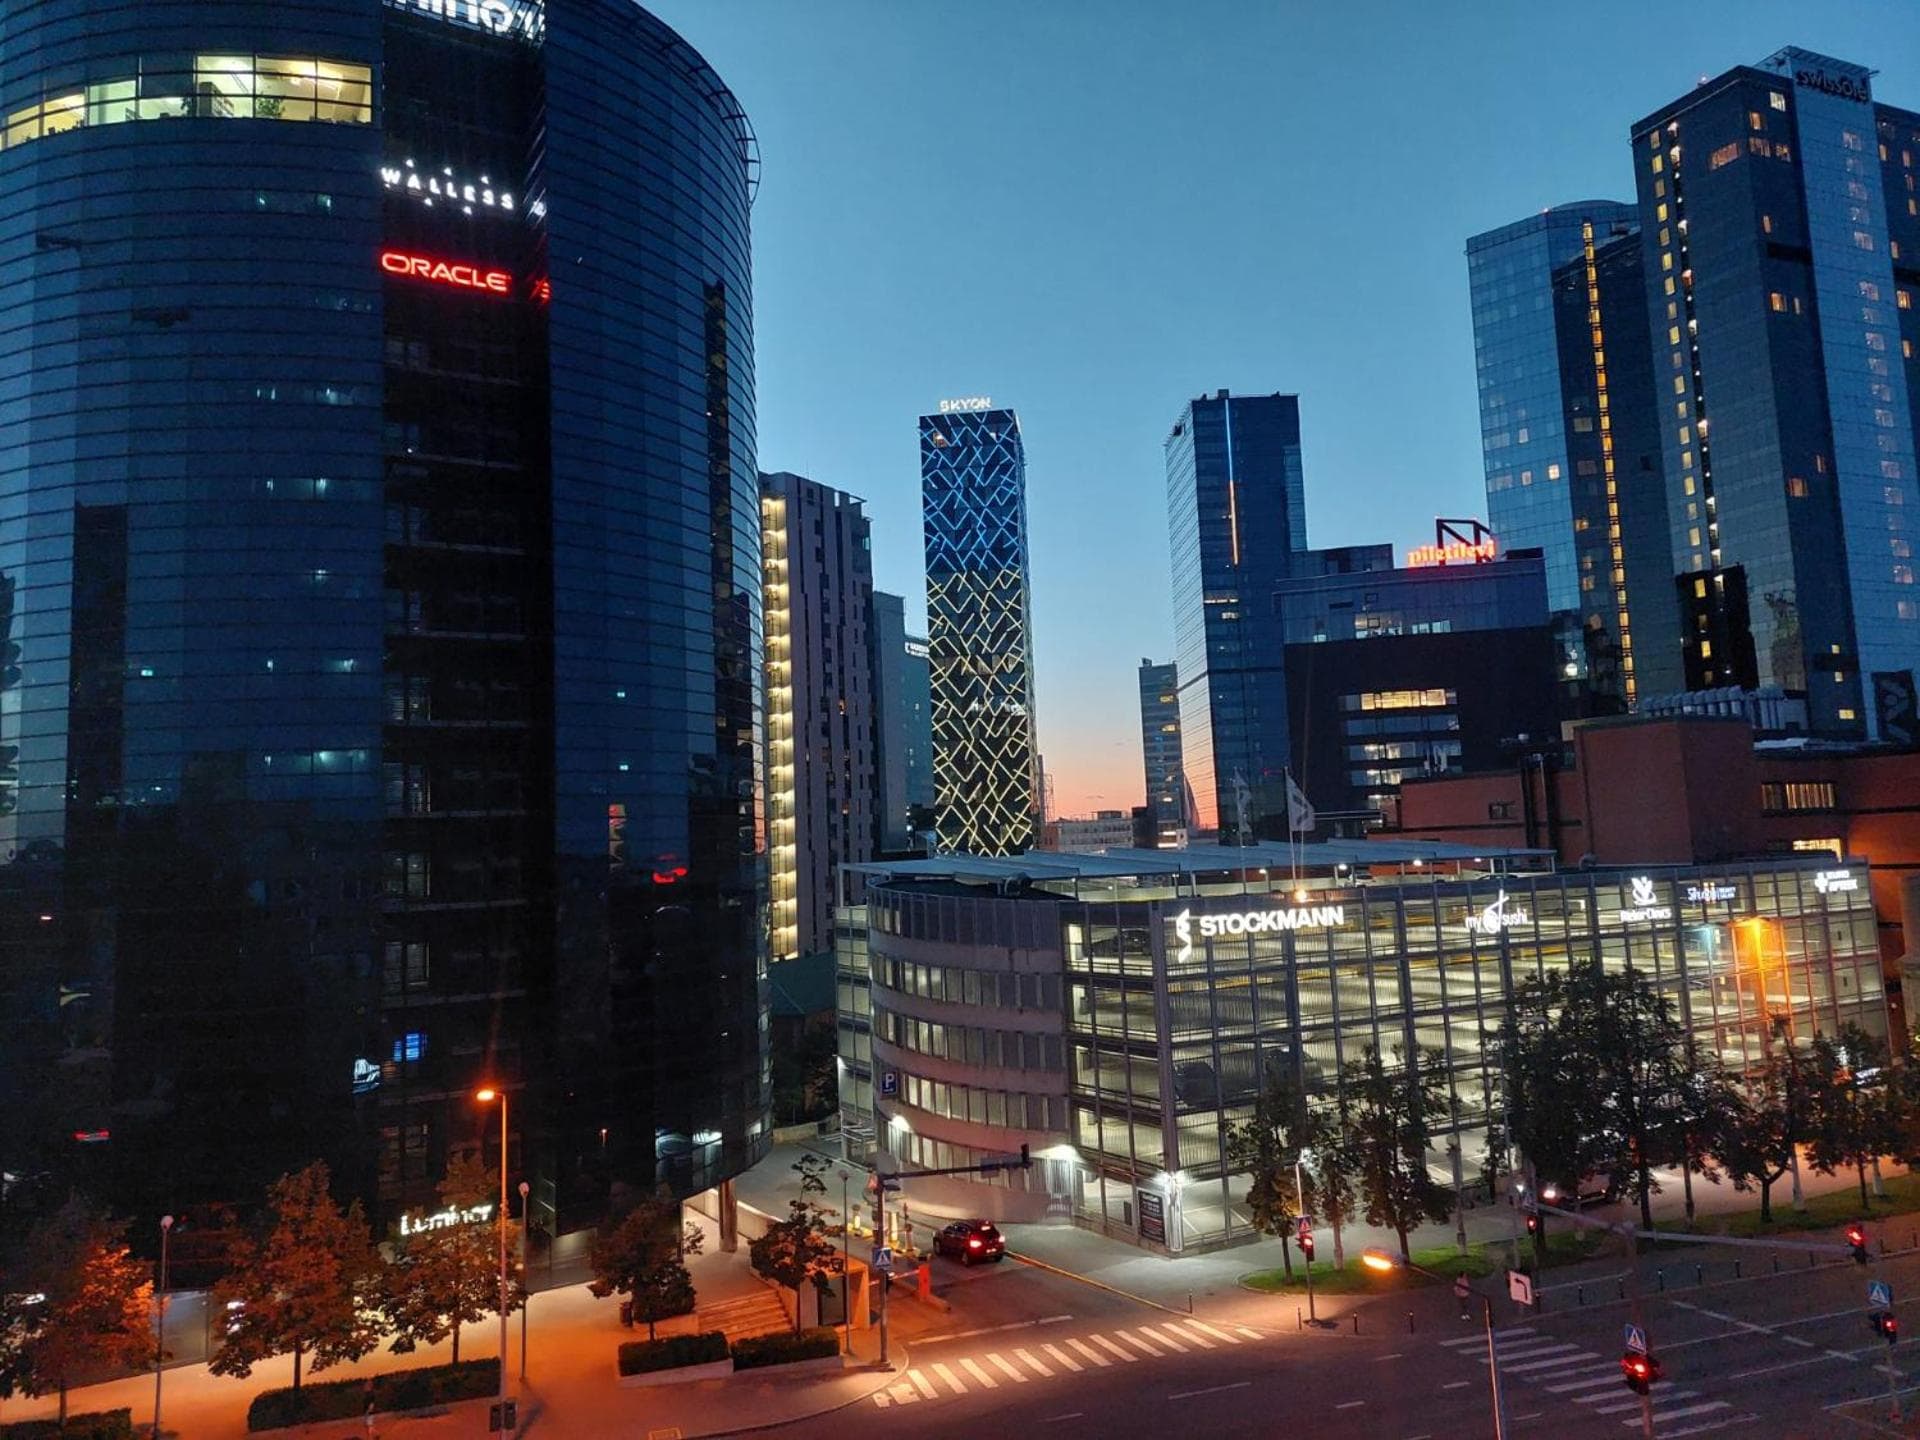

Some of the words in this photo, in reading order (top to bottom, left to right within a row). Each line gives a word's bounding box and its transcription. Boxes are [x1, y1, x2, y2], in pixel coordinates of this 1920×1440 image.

[381, 167, 513, 211] WALLESS
[382, 252, 508, 292] ORACLE
[940, 397, 991, 412] SKYON
[1200, 906, 1343, 936] STOCKMANN
[1502, 907, 1528, 926] sushi
[885, 1073, 895, 1088] P
